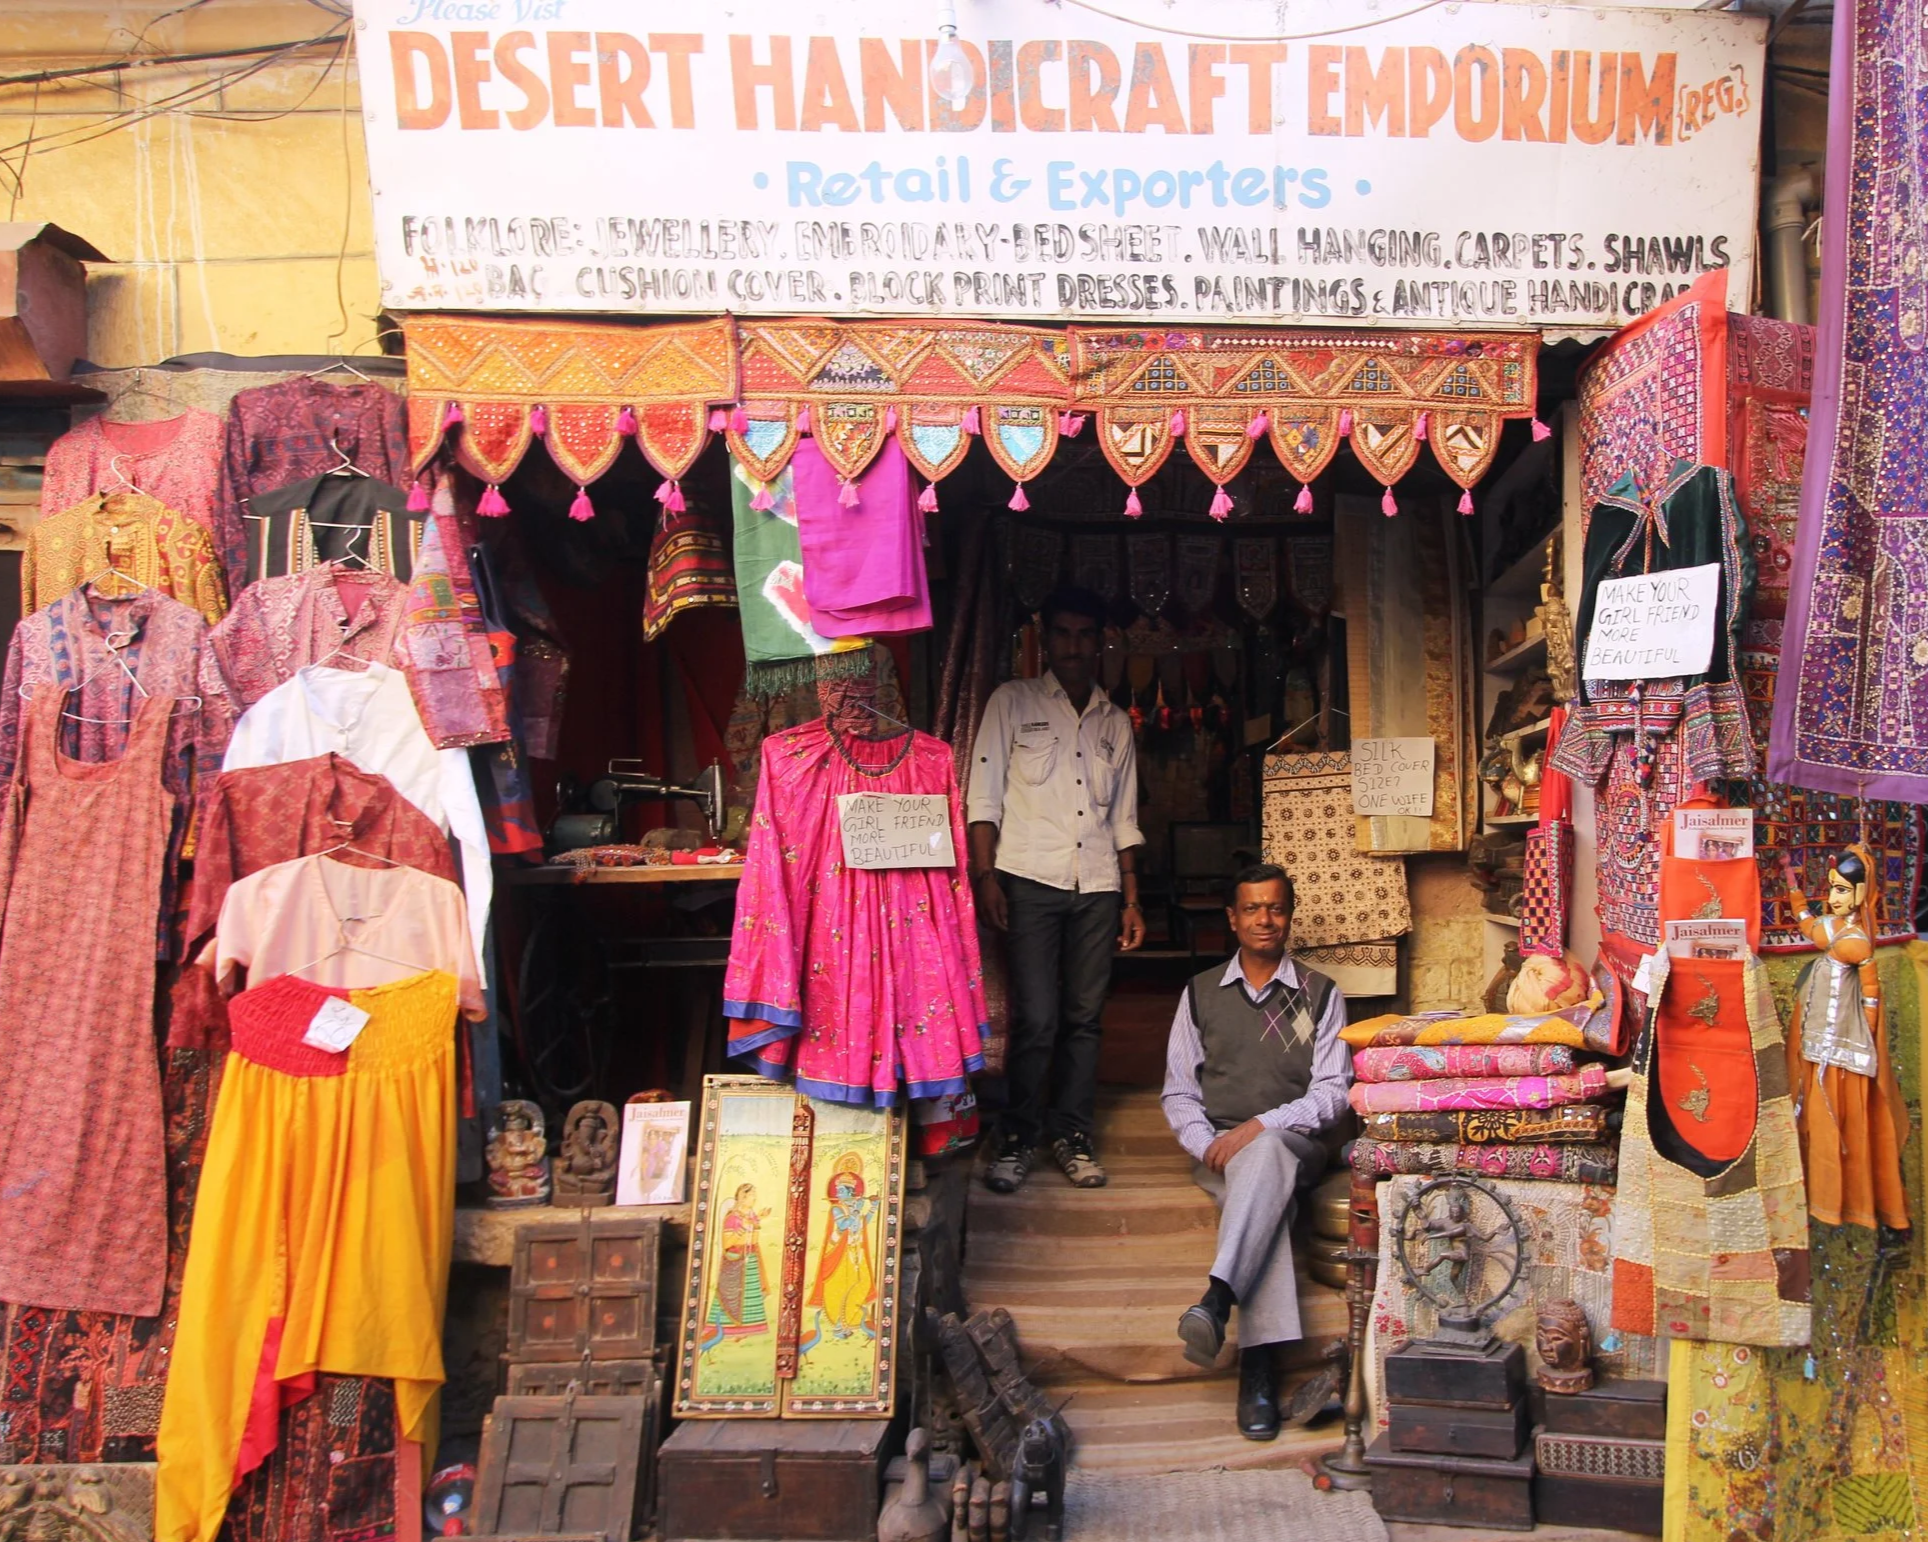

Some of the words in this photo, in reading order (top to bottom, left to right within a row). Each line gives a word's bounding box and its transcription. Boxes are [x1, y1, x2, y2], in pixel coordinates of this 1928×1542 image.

[388, 30, 704, 131] DESERT
[728, 34, 1287, 135] HANDICRAFT
[1308, 42, 1678, 146] EMPORIUM
[786, 156, 970, 207] Retail
[989, 158, 1032, 203] &
[1046, 160, 1331, 217] Exporters
[1197, 225, 1287, 265] WALL
[1603, 232, 1731, 275] SHAWLS
[575, 266, 717, 301] CUSHION
[728, 269, 842, 303] COVER.
[849, 270, 947, 305] BLOCK
[953, 270, 1046, 308] PRINT
[1057, 272, 1189, 310] DRESSES.
[1194, 274, 1367, 315] PAINTINGS
[1392, 278, 1518, 317] ANTIQUE
[1600, 583, 1647, 604] MAKE
[1650, 577, 1692, 603] YOUR
[1598, 606, 1641, 626] GIRL
[1646, 604, 1700, 626] FRIEND
[1597, 627, 1641, 643] MORE
[1590, 647, 1681, 666] BEAUTIFUL
[1360, 741, 1406, 761] SILK
[1354, 762, 1383, 777] BED
[1358, 776, 1401, 793] SIZE?
[844, 797, 884, 816] MAKE
[893, 796, 933, 815] YOUR
[1358, 793, 1388, 808] ONE
[1391, 793, 1428, 806] WIFE
[843, 816, 885, 832] GIRL
[894, 813, 944, 829] FRIEND
[1680, 813, 1749, 830] Jaisalmer
[850, 831, 886, 846] MORE
[851, 843, 938, 865] BEAUTIFUL
[1671, 924, 1741, 941] Jaisalmer
[628, 1107, 686, 1122] Jaisalmer
